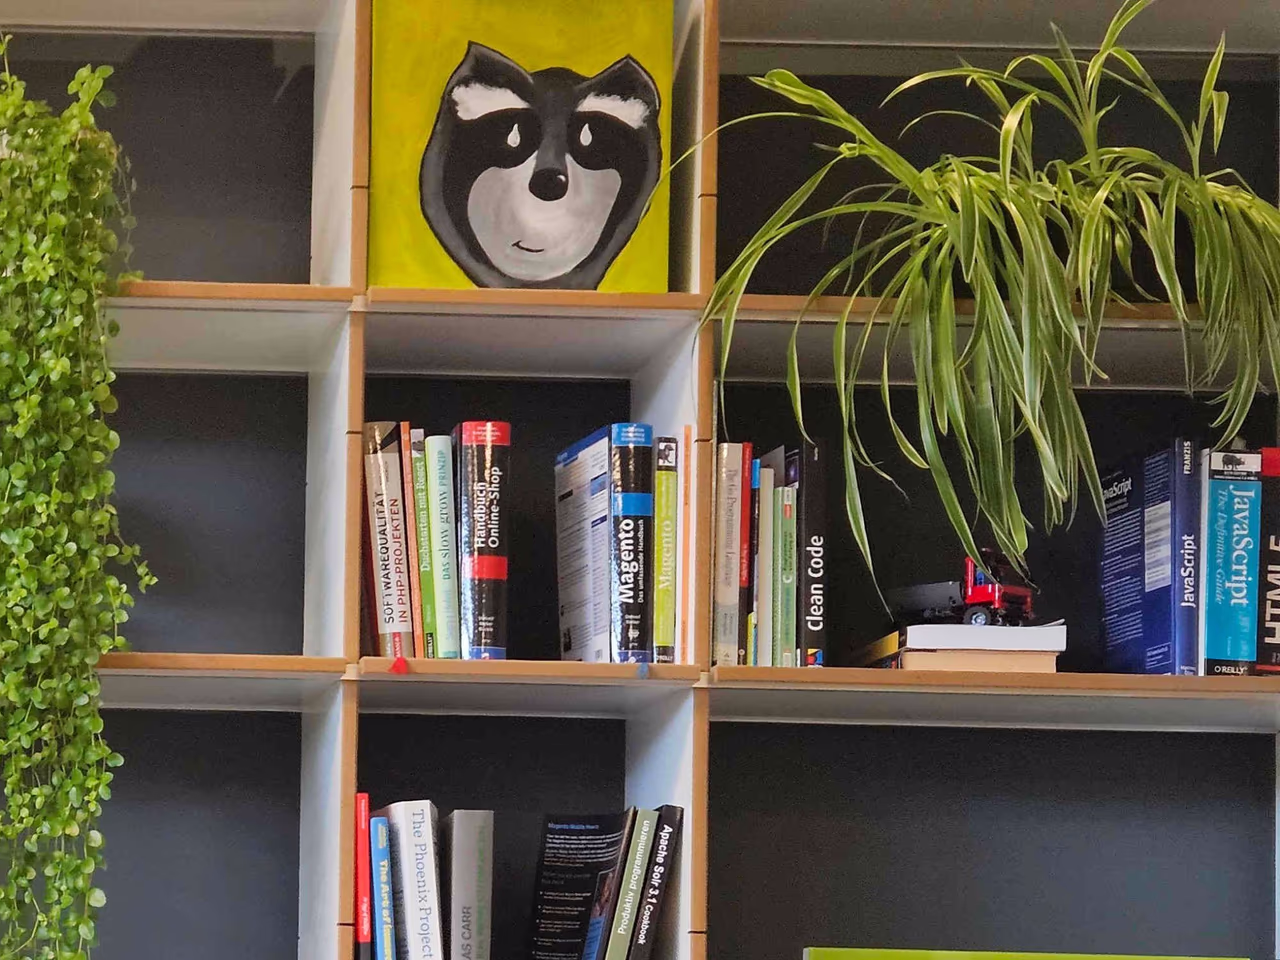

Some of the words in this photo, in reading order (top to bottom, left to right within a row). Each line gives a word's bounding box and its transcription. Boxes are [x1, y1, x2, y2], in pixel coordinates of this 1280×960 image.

[437, 449, 447, 487] PRINZIP
[1183, 440, 1192, 475] FRANZIS
[438, 489, 451, 524] grow
[474, 482, 486, 547] Handbuch
[487, 466, 502, 548] Online-Shop
[373, 490, 396, 624] SOFTWAREQUALITÄT
[390, 498, 407, 600] PHP-PROJEKTEN
[438, 528, 451, 559] slow
[618, 518, 638, 604] Magento
[658, 520, 672, 589] Magento
[805, 535, 824, 577] Code
[1226, 484, 1255, 606] JavaScript
[441, 562, 451, 580] DAS
[1180, 534, 1197, 608] JavaScript
[398, 606, 408, 623] IN
[806, 581, 824, 632] Clean
[1214, 665, 1248, 674] O'REILLY
[412, 809, 425, 837] The
[654, 823, 673, 860] Apache
[414, 842, 429, 904] Phoenix
[617, 891, 636, 935] Produktiv
[628, 819, 651, 889] programmieren
[651, 860, 666, 885] Solr
[646, 886, 660, 905] 3.1
[417, 906, 433, 959] Project
[461, 906, 472, 940] CARR
[637, 904, 654, 945] Cookbook
